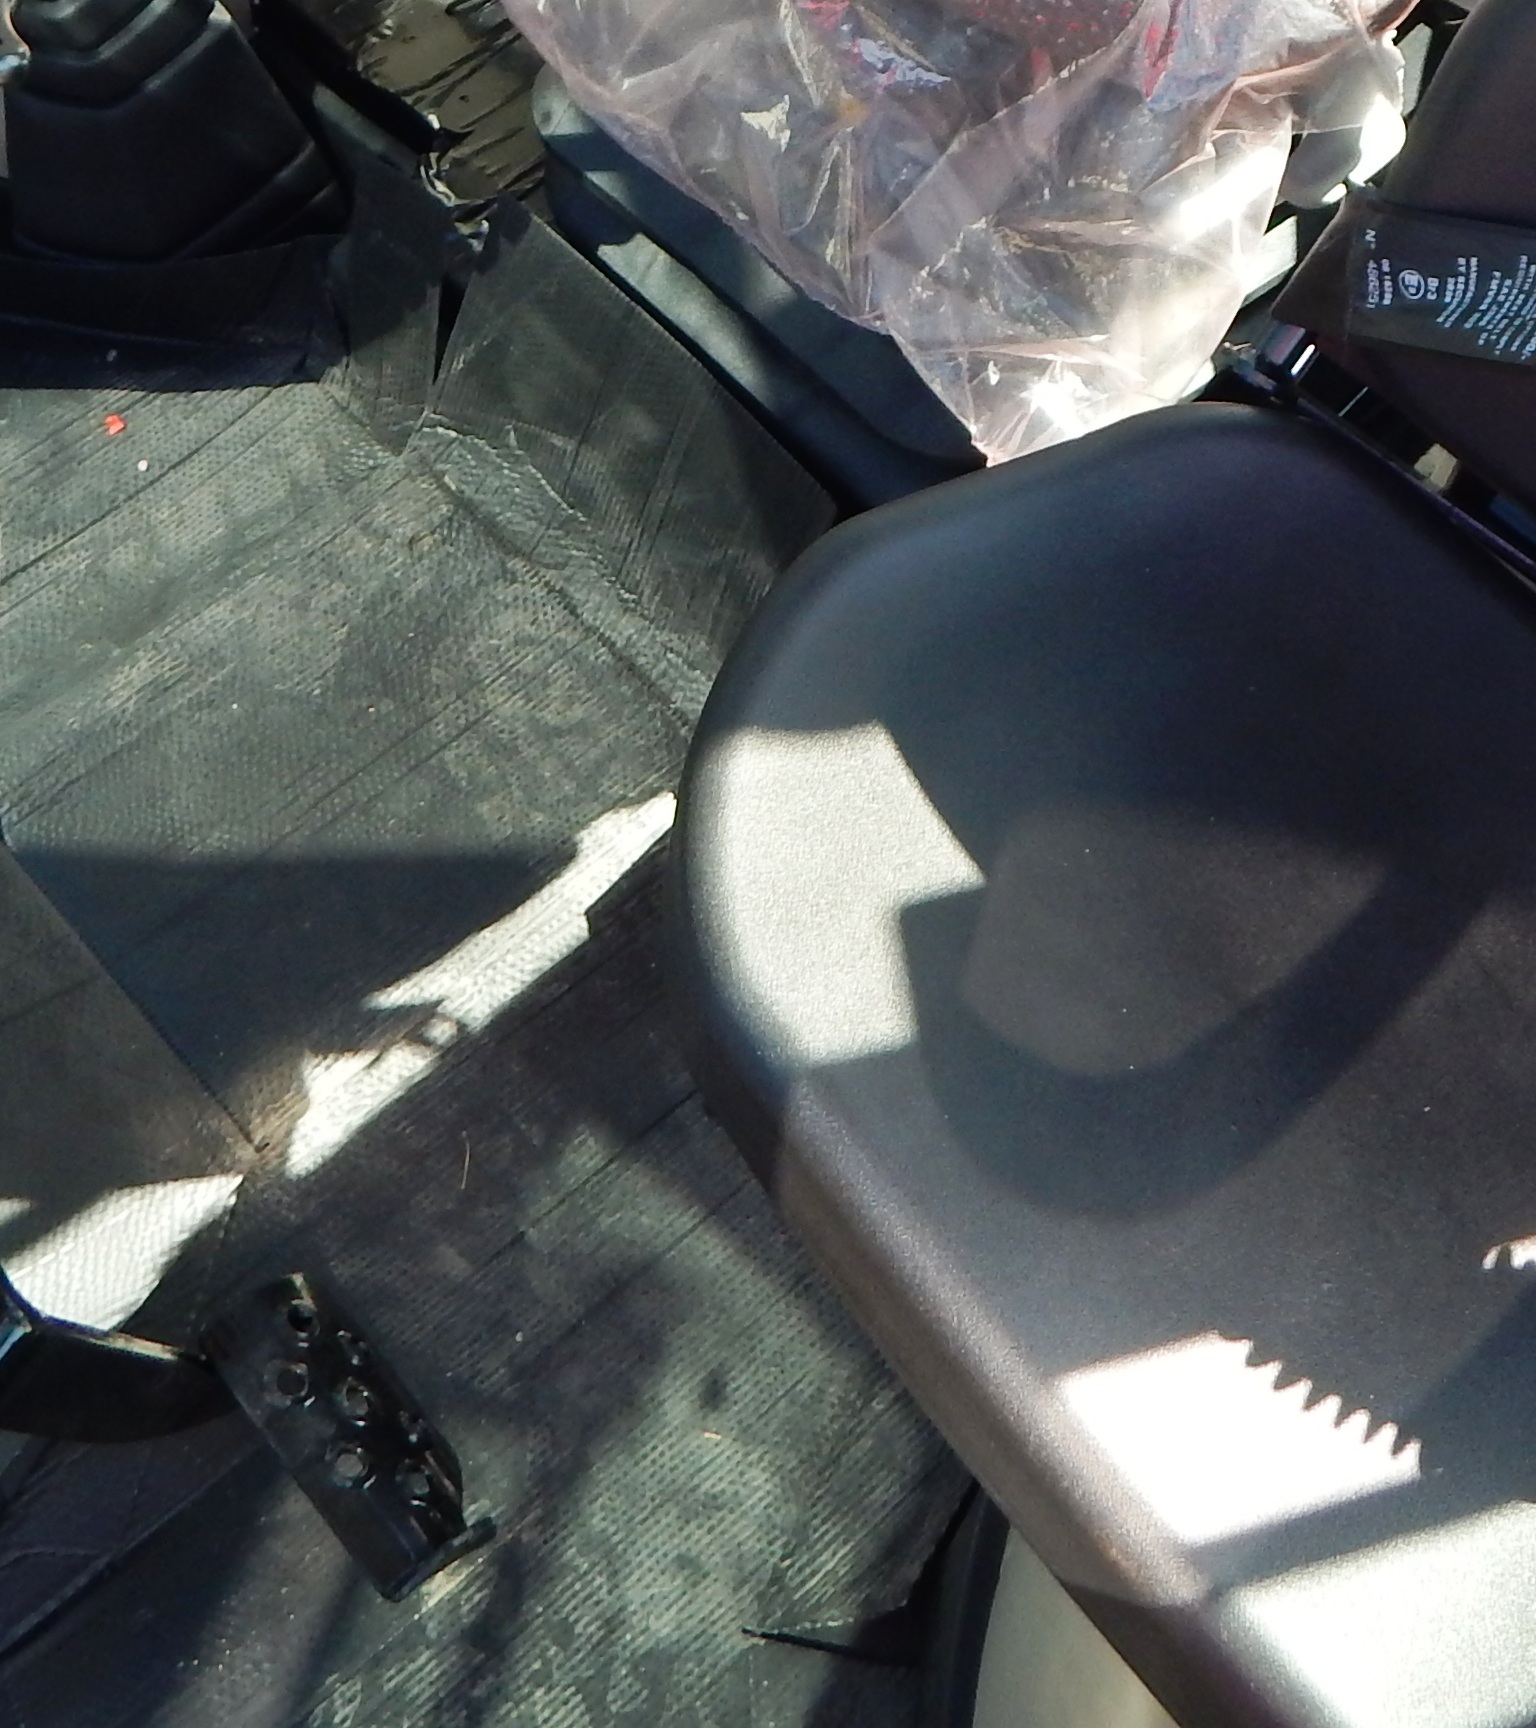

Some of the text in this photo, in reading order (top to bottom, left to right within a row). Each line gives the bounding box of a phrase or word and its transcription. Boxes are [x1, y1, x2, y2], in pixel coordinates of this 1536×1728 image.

[1444, 257, 1478, 328] MANUFACTURED
[1486, 255, 1528, 329] REQUIREMENTS
[1523, 264, 1536, 291] WITH
